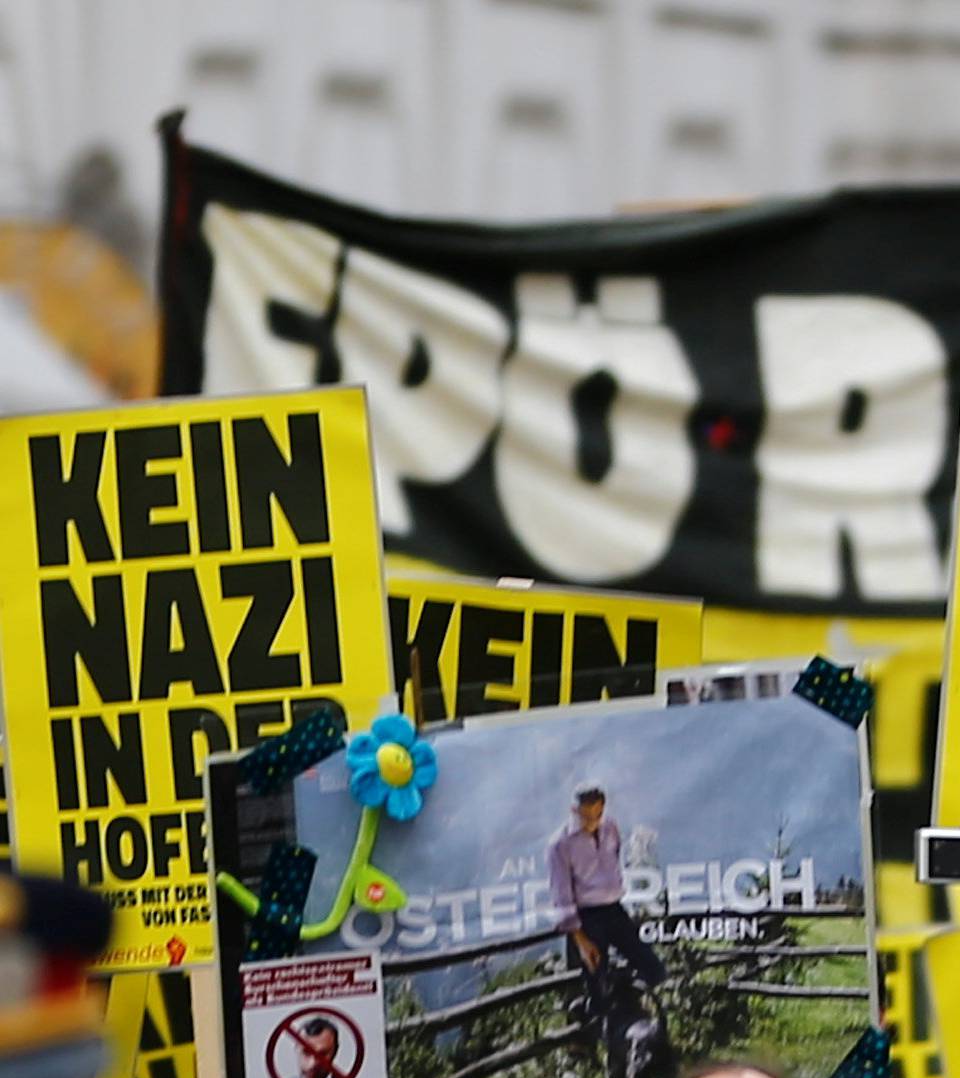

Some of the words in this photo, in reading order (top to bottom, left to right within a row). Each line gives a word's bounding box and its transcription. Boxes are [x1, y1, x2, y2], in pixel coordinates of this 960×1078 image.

[28, 411, 330, 567] KEIN
[39, 556, 343, 708] NAZI
[388, 596, 658, 723] KEIN
[51, 711, 148, 811] IN
[142, 887, 170, 904] MIT
[142, 905, 177, 928] VON
[500, 856, 535, 879] AN
